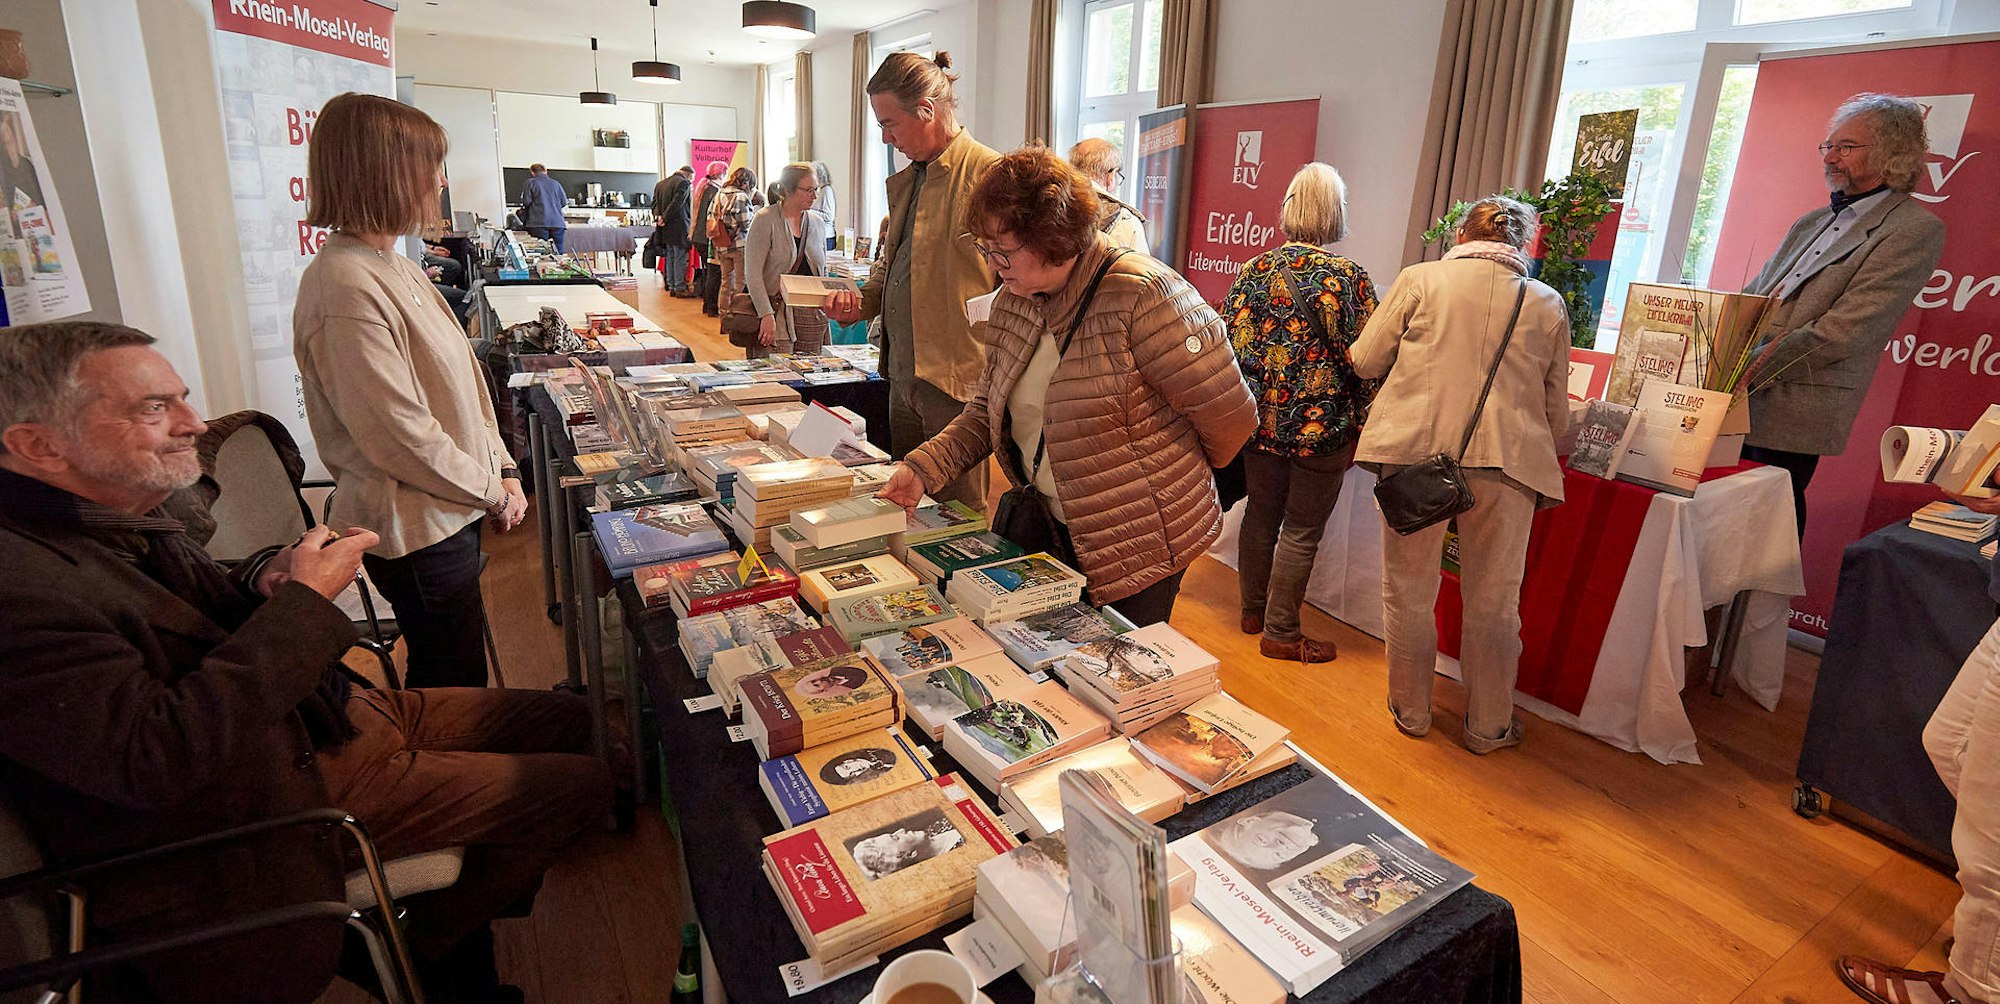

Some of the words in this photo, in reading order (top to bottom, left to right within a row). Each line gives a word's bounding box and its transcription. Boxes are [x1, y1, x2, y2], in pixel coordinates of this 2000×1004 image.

[230, 0, 390, 58] Rhein-Mosel-Verlag
[695, 145, 732, 153] Kulturhof
[1579, 139, 1625, 168] Eifel
[1232, 161, 1264, 189] ELV
[1206, 211, 1275, 248] Eifeler
[1188, 251, 1244, 275] Literatur
[1643, 294, 1672, 309] UNSER
[1674, 298, 1704, 313] NEUER
[1647, 309, 1694, 326] EIFELKRIMI
[1639, 356, 1675, 375] STELING
[1664, 392, 1705, 409] STELING
[1915, 428, 1938, 476] Rhein-Mo
[966, 569, 992, 586] Eifel
[1201, 857, 1316, 959] Rhein-Mosel-Verlag
[1192, 965, 1220, 992] Wacht
